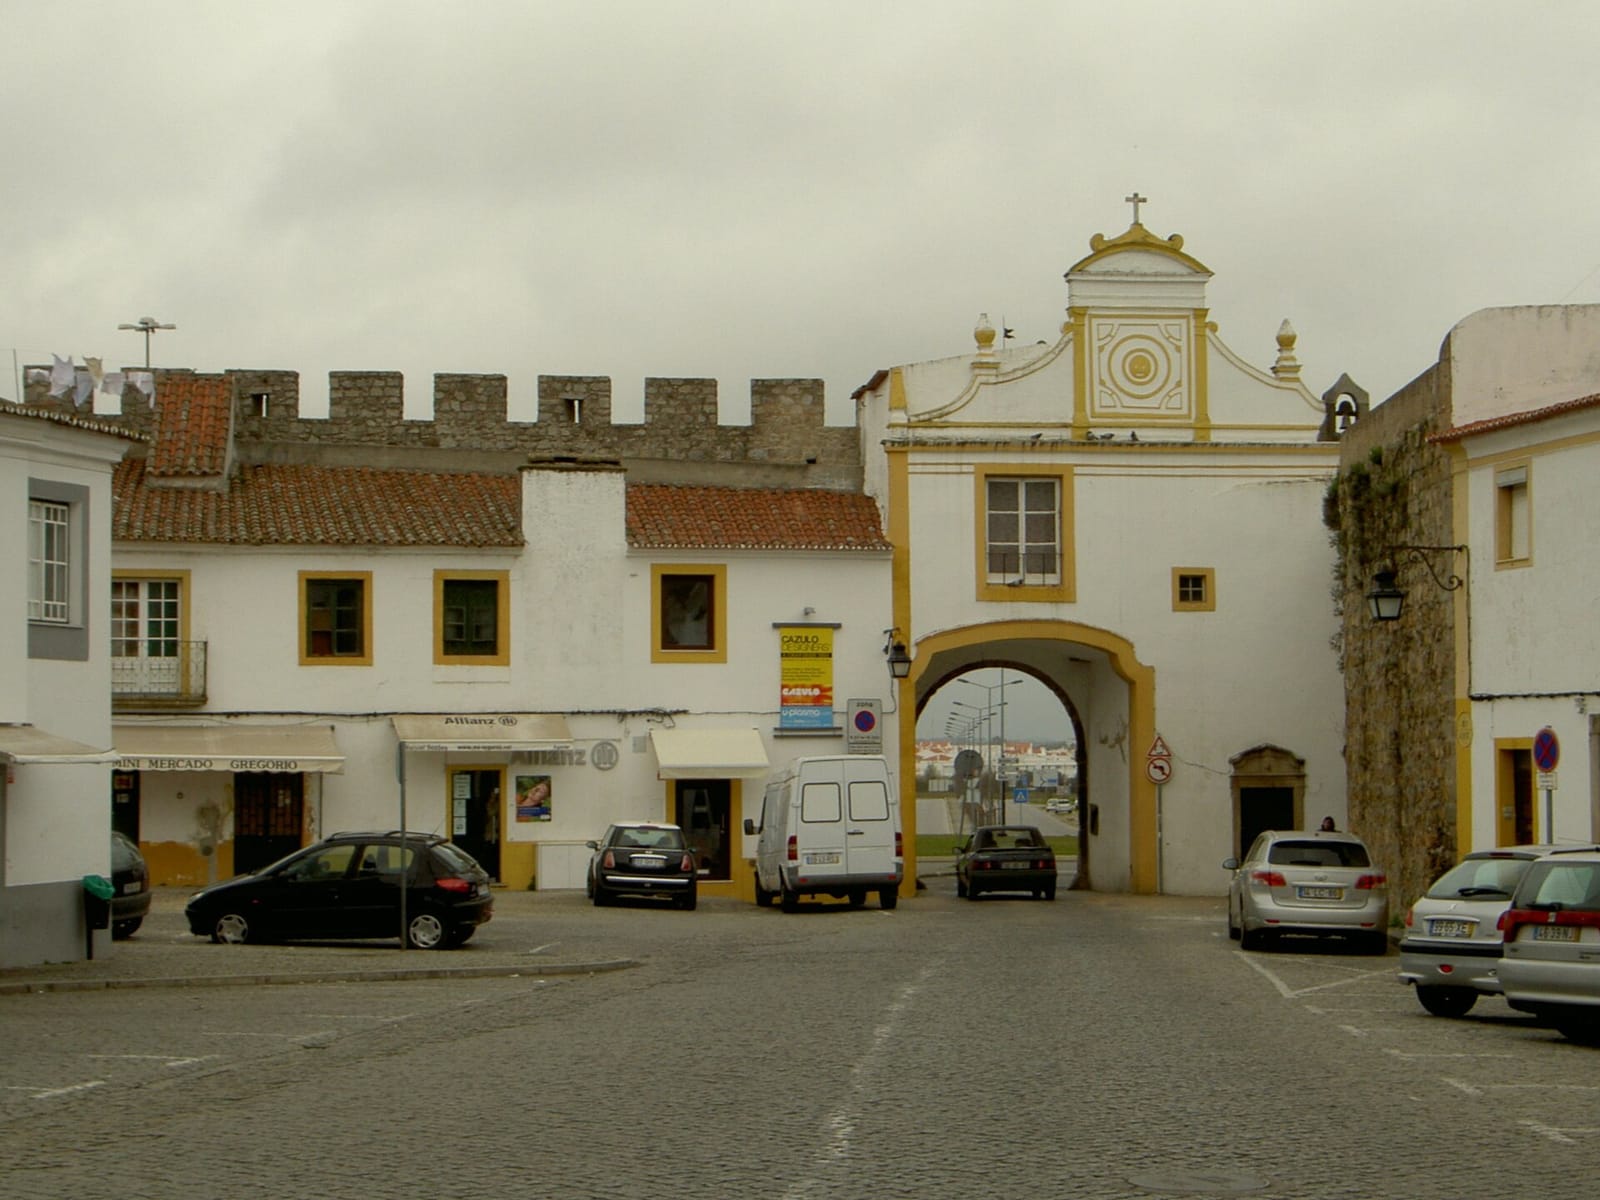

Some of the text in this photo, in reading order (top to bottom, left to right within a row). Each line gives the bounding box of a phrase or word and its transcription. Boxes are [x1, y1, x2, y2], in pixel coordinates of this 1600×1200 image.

[781, 635, 819, 643] CAZULO
[782, 687, 821, 696] CAZULO
[444, 717, 496, 726] Allianz
[511, 747, 586, 766] Allianz
[112, 759, 298, 770] MINI MERCADO GREGORIO
